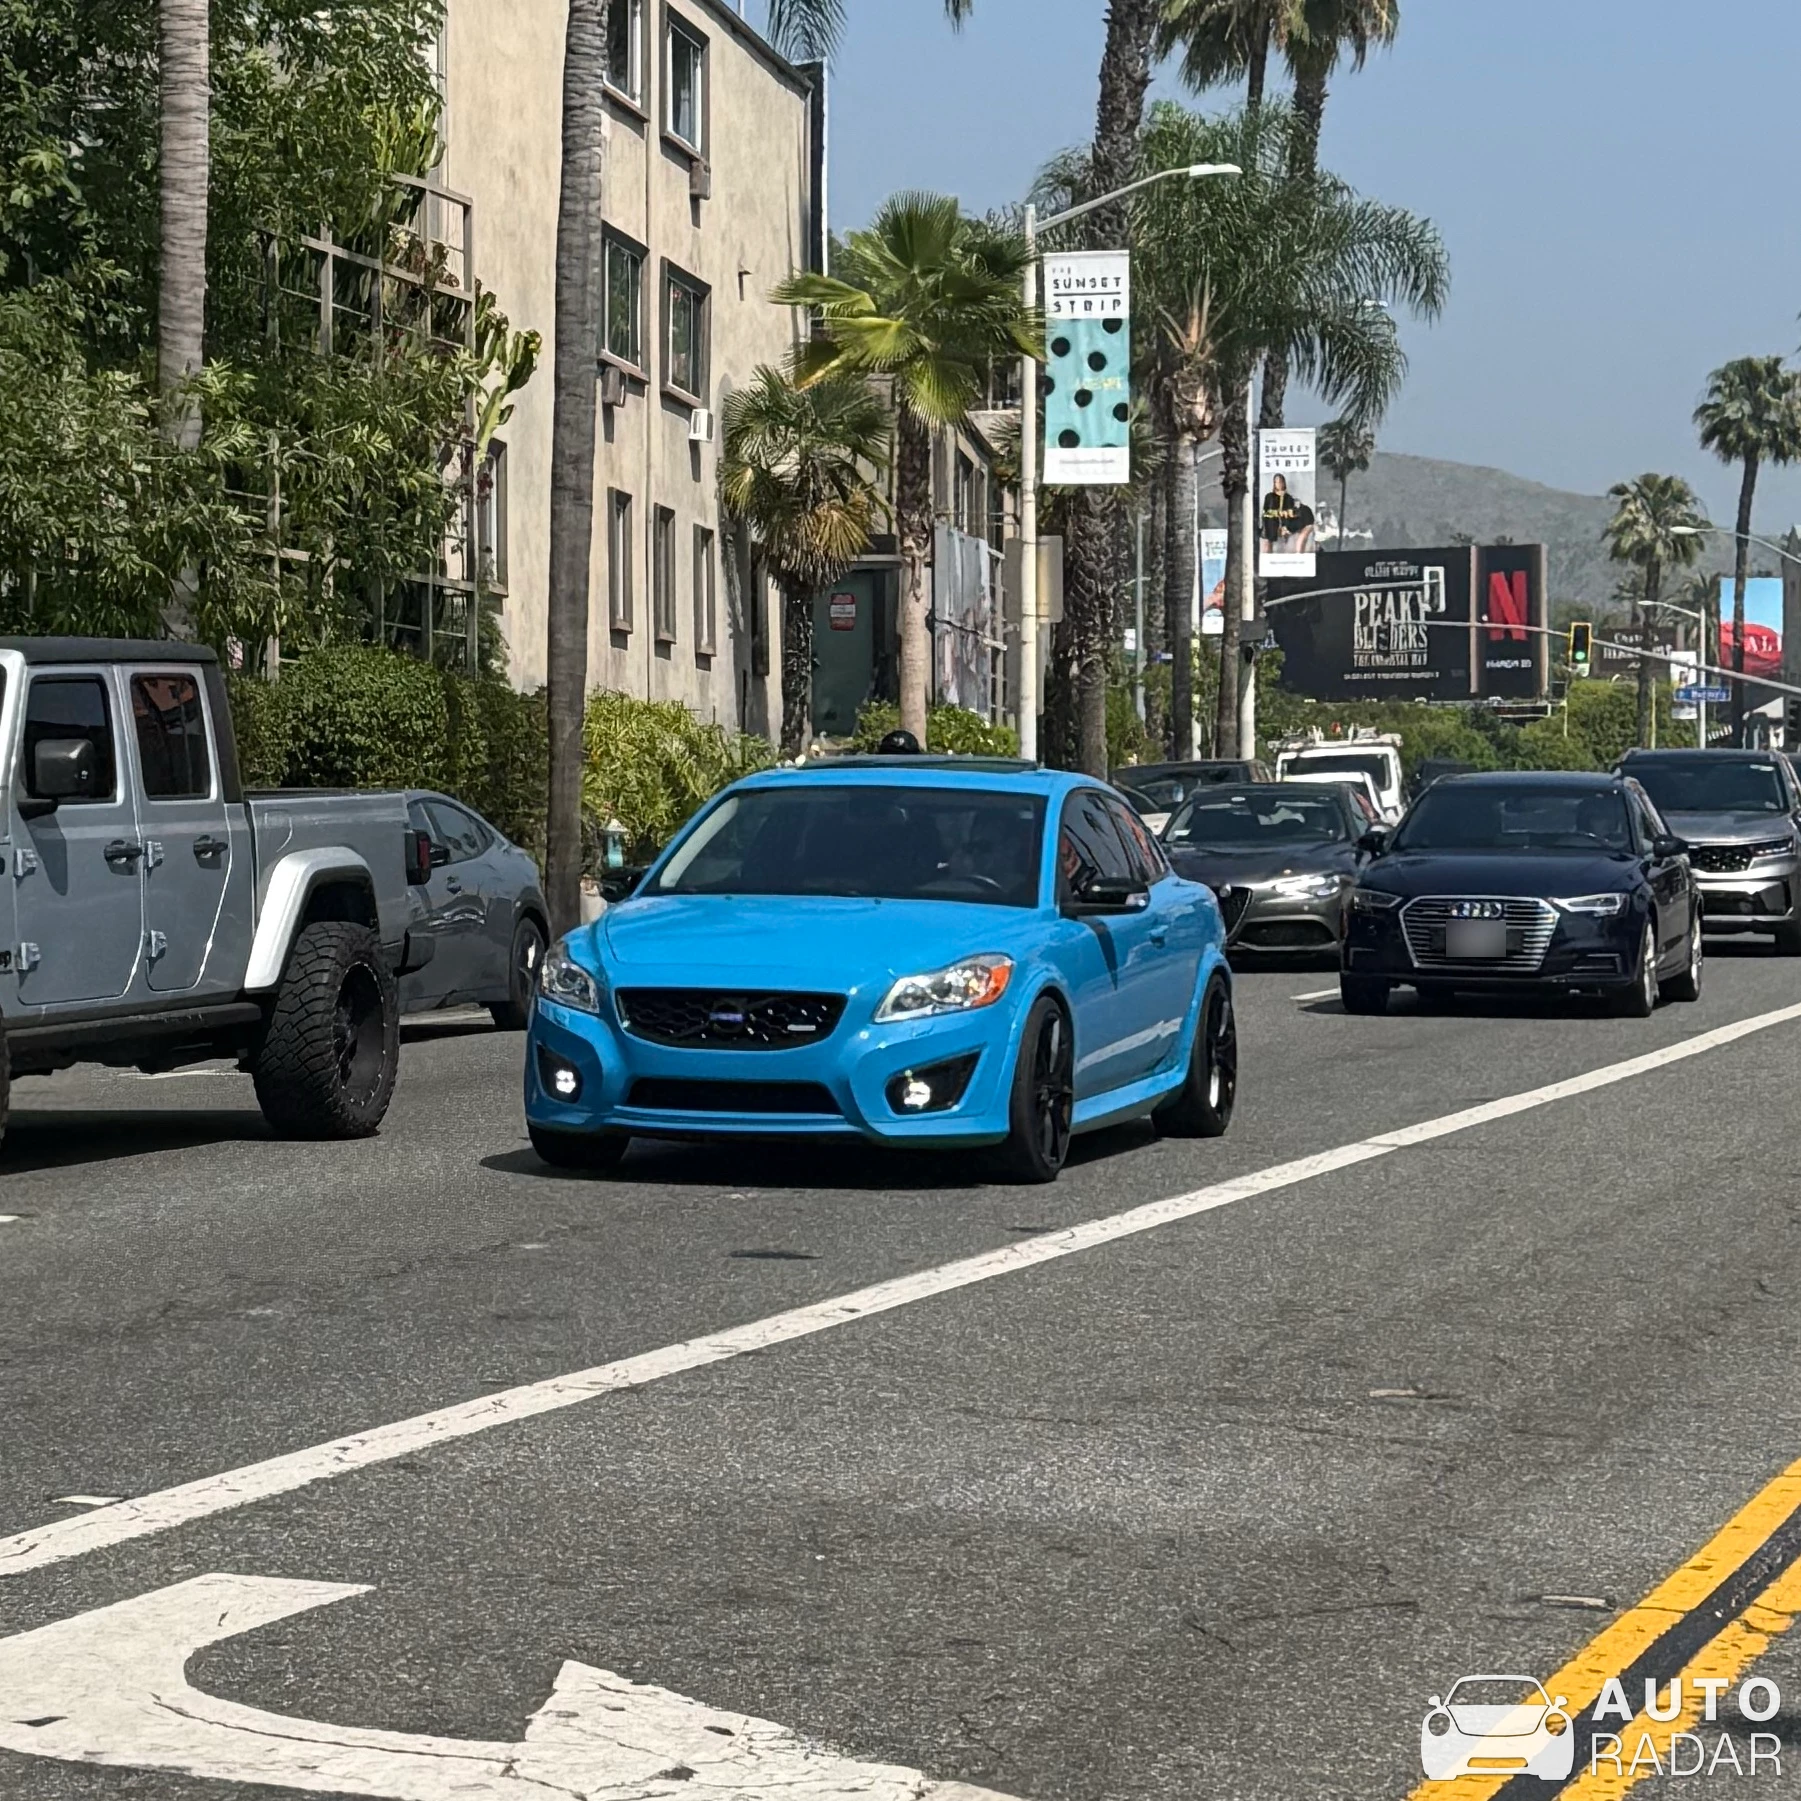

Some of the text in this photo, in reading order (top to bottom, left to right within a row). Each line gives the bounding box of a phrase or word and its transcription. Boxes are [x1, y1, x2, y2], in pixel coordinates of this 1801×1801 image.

[1053, 277, 1121, 289] SUNSET
[1053, 299, 1121, 313] STRIP
[1353, 591, 1427, 626] PEAKY
